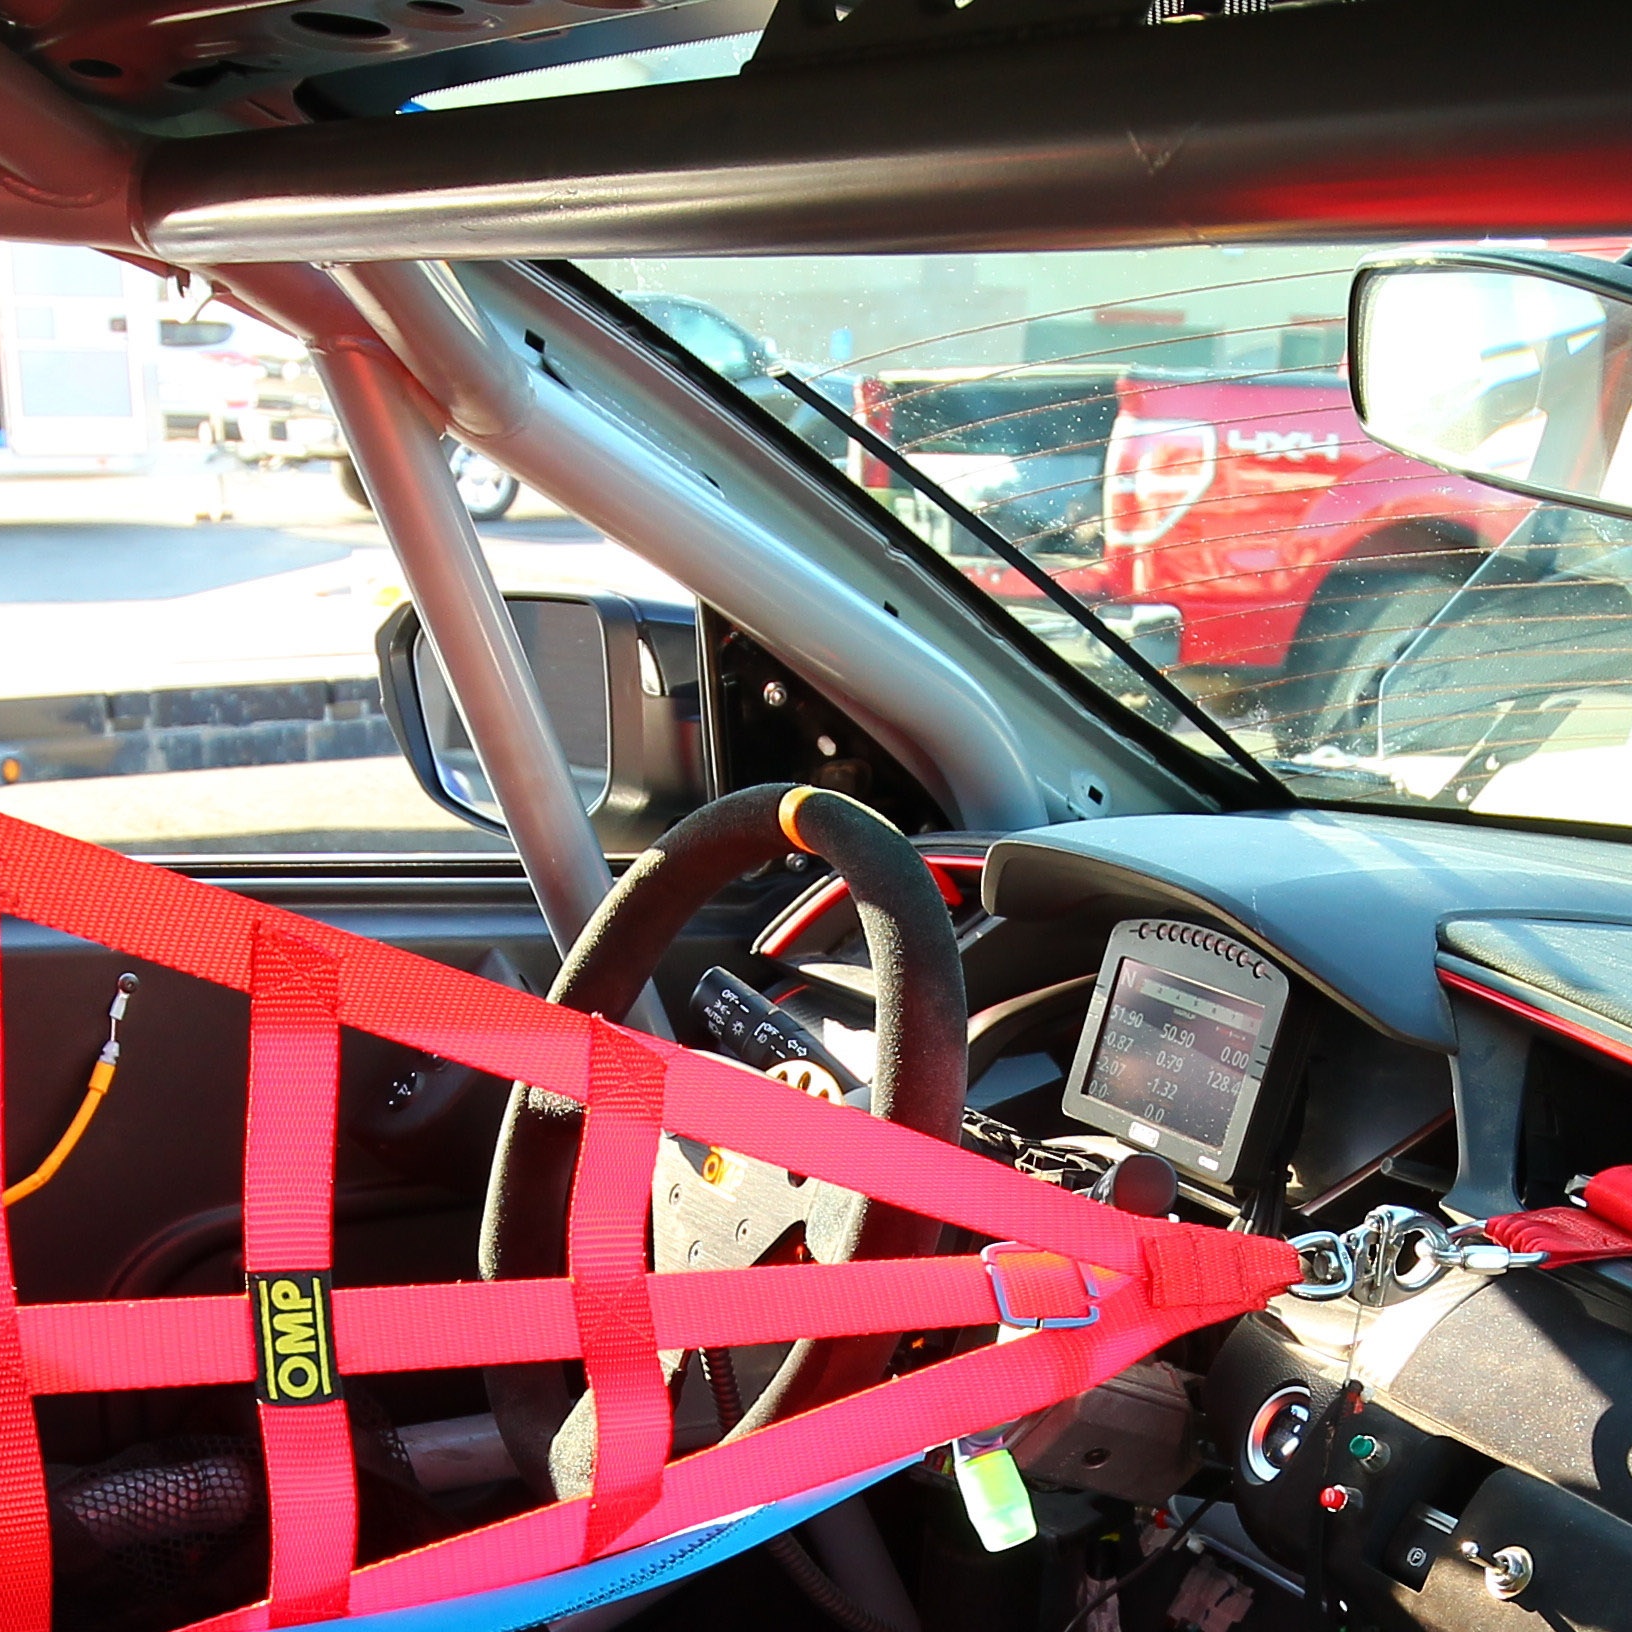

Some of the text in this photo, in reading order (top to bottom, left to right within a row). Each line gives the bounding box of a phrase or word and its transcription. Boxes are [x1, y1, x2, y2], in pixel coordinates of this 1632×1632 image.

[1120, 970, 1138, 989] N
[1159, 1022, 1196, 1049] 50.90
[1220, 1045, 1250, 1070] 0.00
[270, 1279, 320, 1399] OMP
